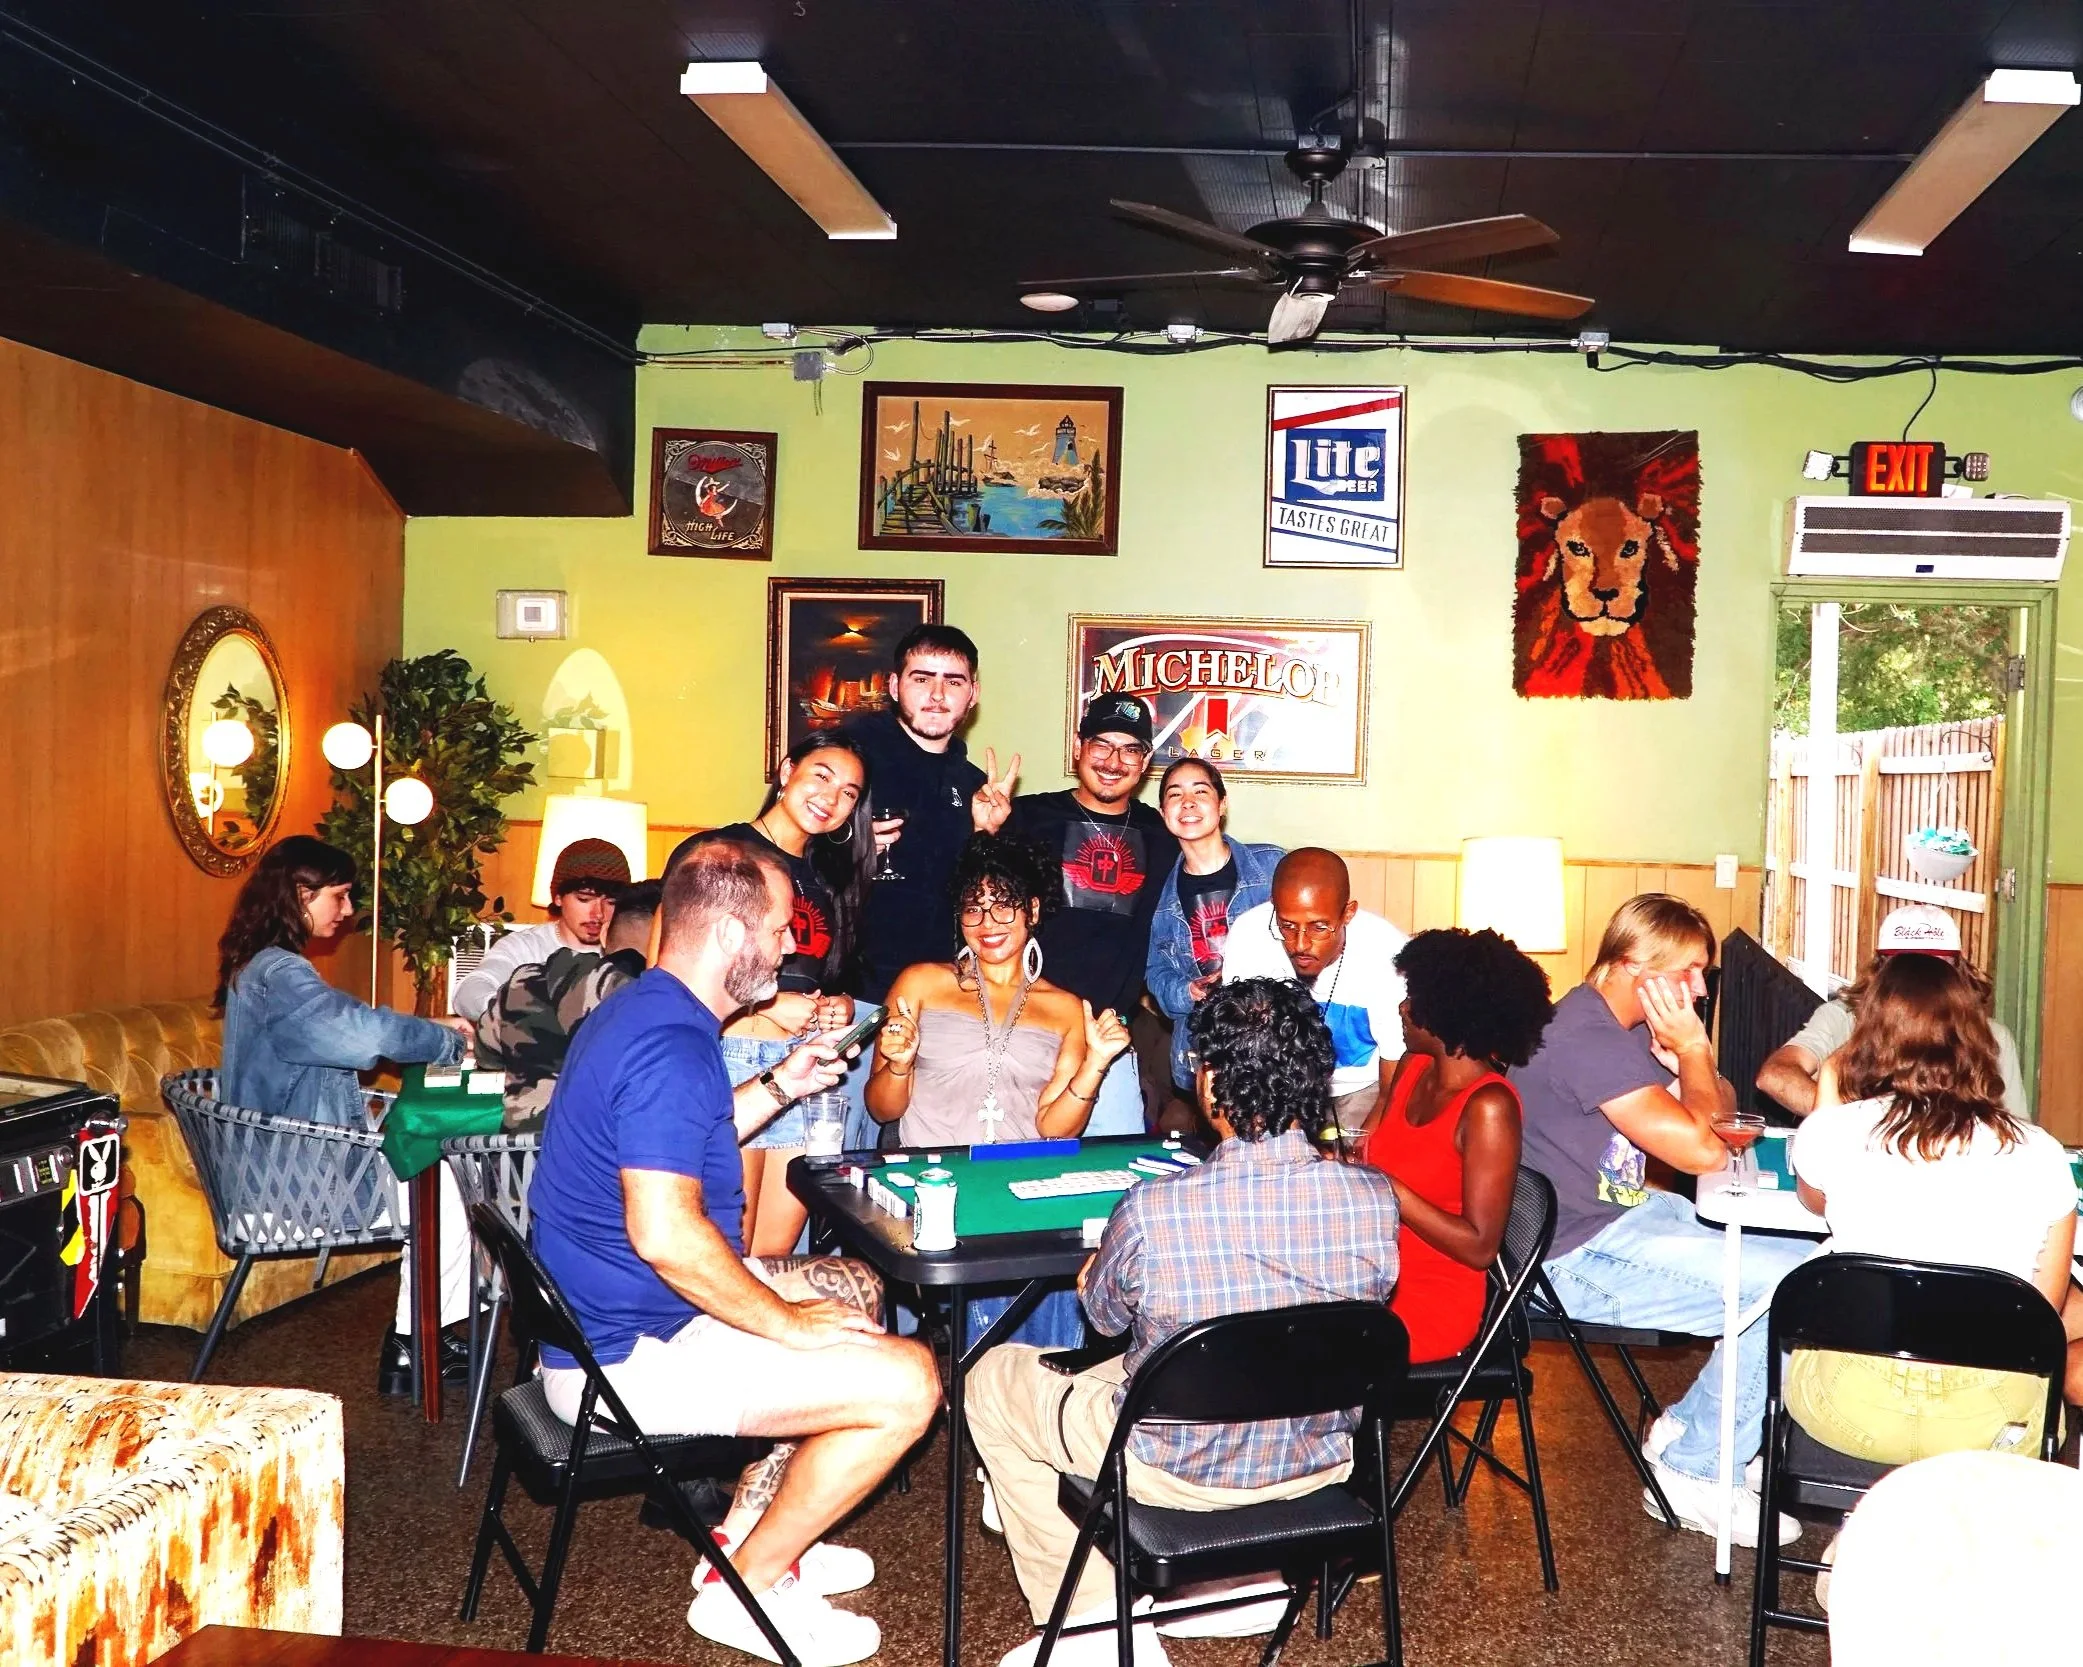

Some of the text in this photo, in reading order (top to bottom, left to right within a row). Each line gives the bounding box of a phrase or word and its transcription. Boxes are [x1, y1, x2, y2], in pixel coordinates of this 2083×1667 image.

[1290, 438, 1380, 496] Lite
[1867, 444, 1934, 492] EXIT
[685, 520, 735, 541] HIGH LIFE
[1279, 506, 1389, 543] TASTES GREAT
[1167, 746, 1267, 761] LAGER
